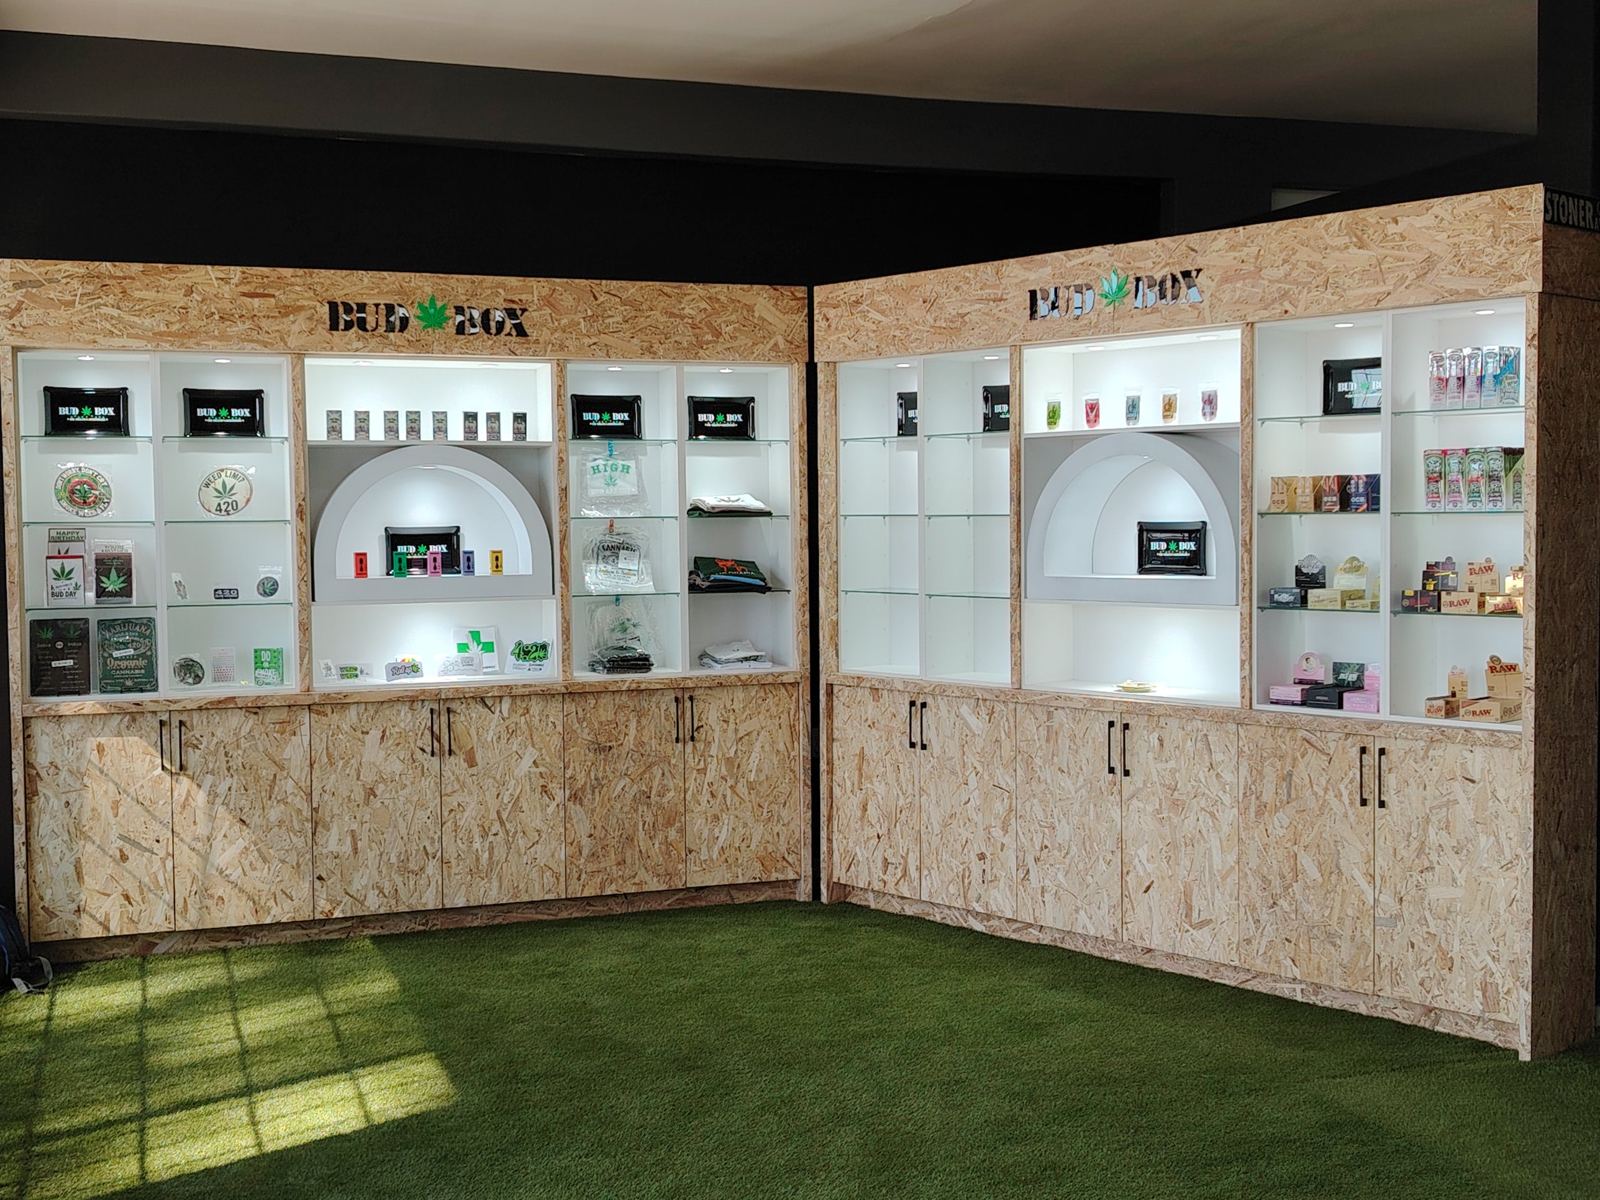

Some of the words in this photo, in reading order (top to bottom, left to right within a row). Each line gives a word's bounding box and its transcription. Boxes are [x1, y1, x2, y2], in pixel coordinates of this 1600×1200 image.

[1028, 283, 1095, 320] BUD
[1133, 268, 1203, 309] BOX
[327, 301, 410, 333] BUD
[453, 305, 529, 337] BOX
[58, 407, 79, 415] BUD
[94, 407, 115, 415] BOX
[196, 408, 217, 416] BUD
[230, 408, 251, 416] BOX
[612, 412, 630, 420] BOX
[591, 463, 631, 475] HIGH
[202, 472, 222, 488] WEED
[224, 471, 245, 483] LIMIT
[215, 500, 239, 513] 420
[429, 545, 448, 553] BOX
[1150, 542, 1167, 550] BUD
[1179, 542, 1197, 550] BOX
[1469, 565, 1495, 576] RAW
[1449, 599, 1471, 608] RAW
[1489, 664, 1518, 673] RAW
